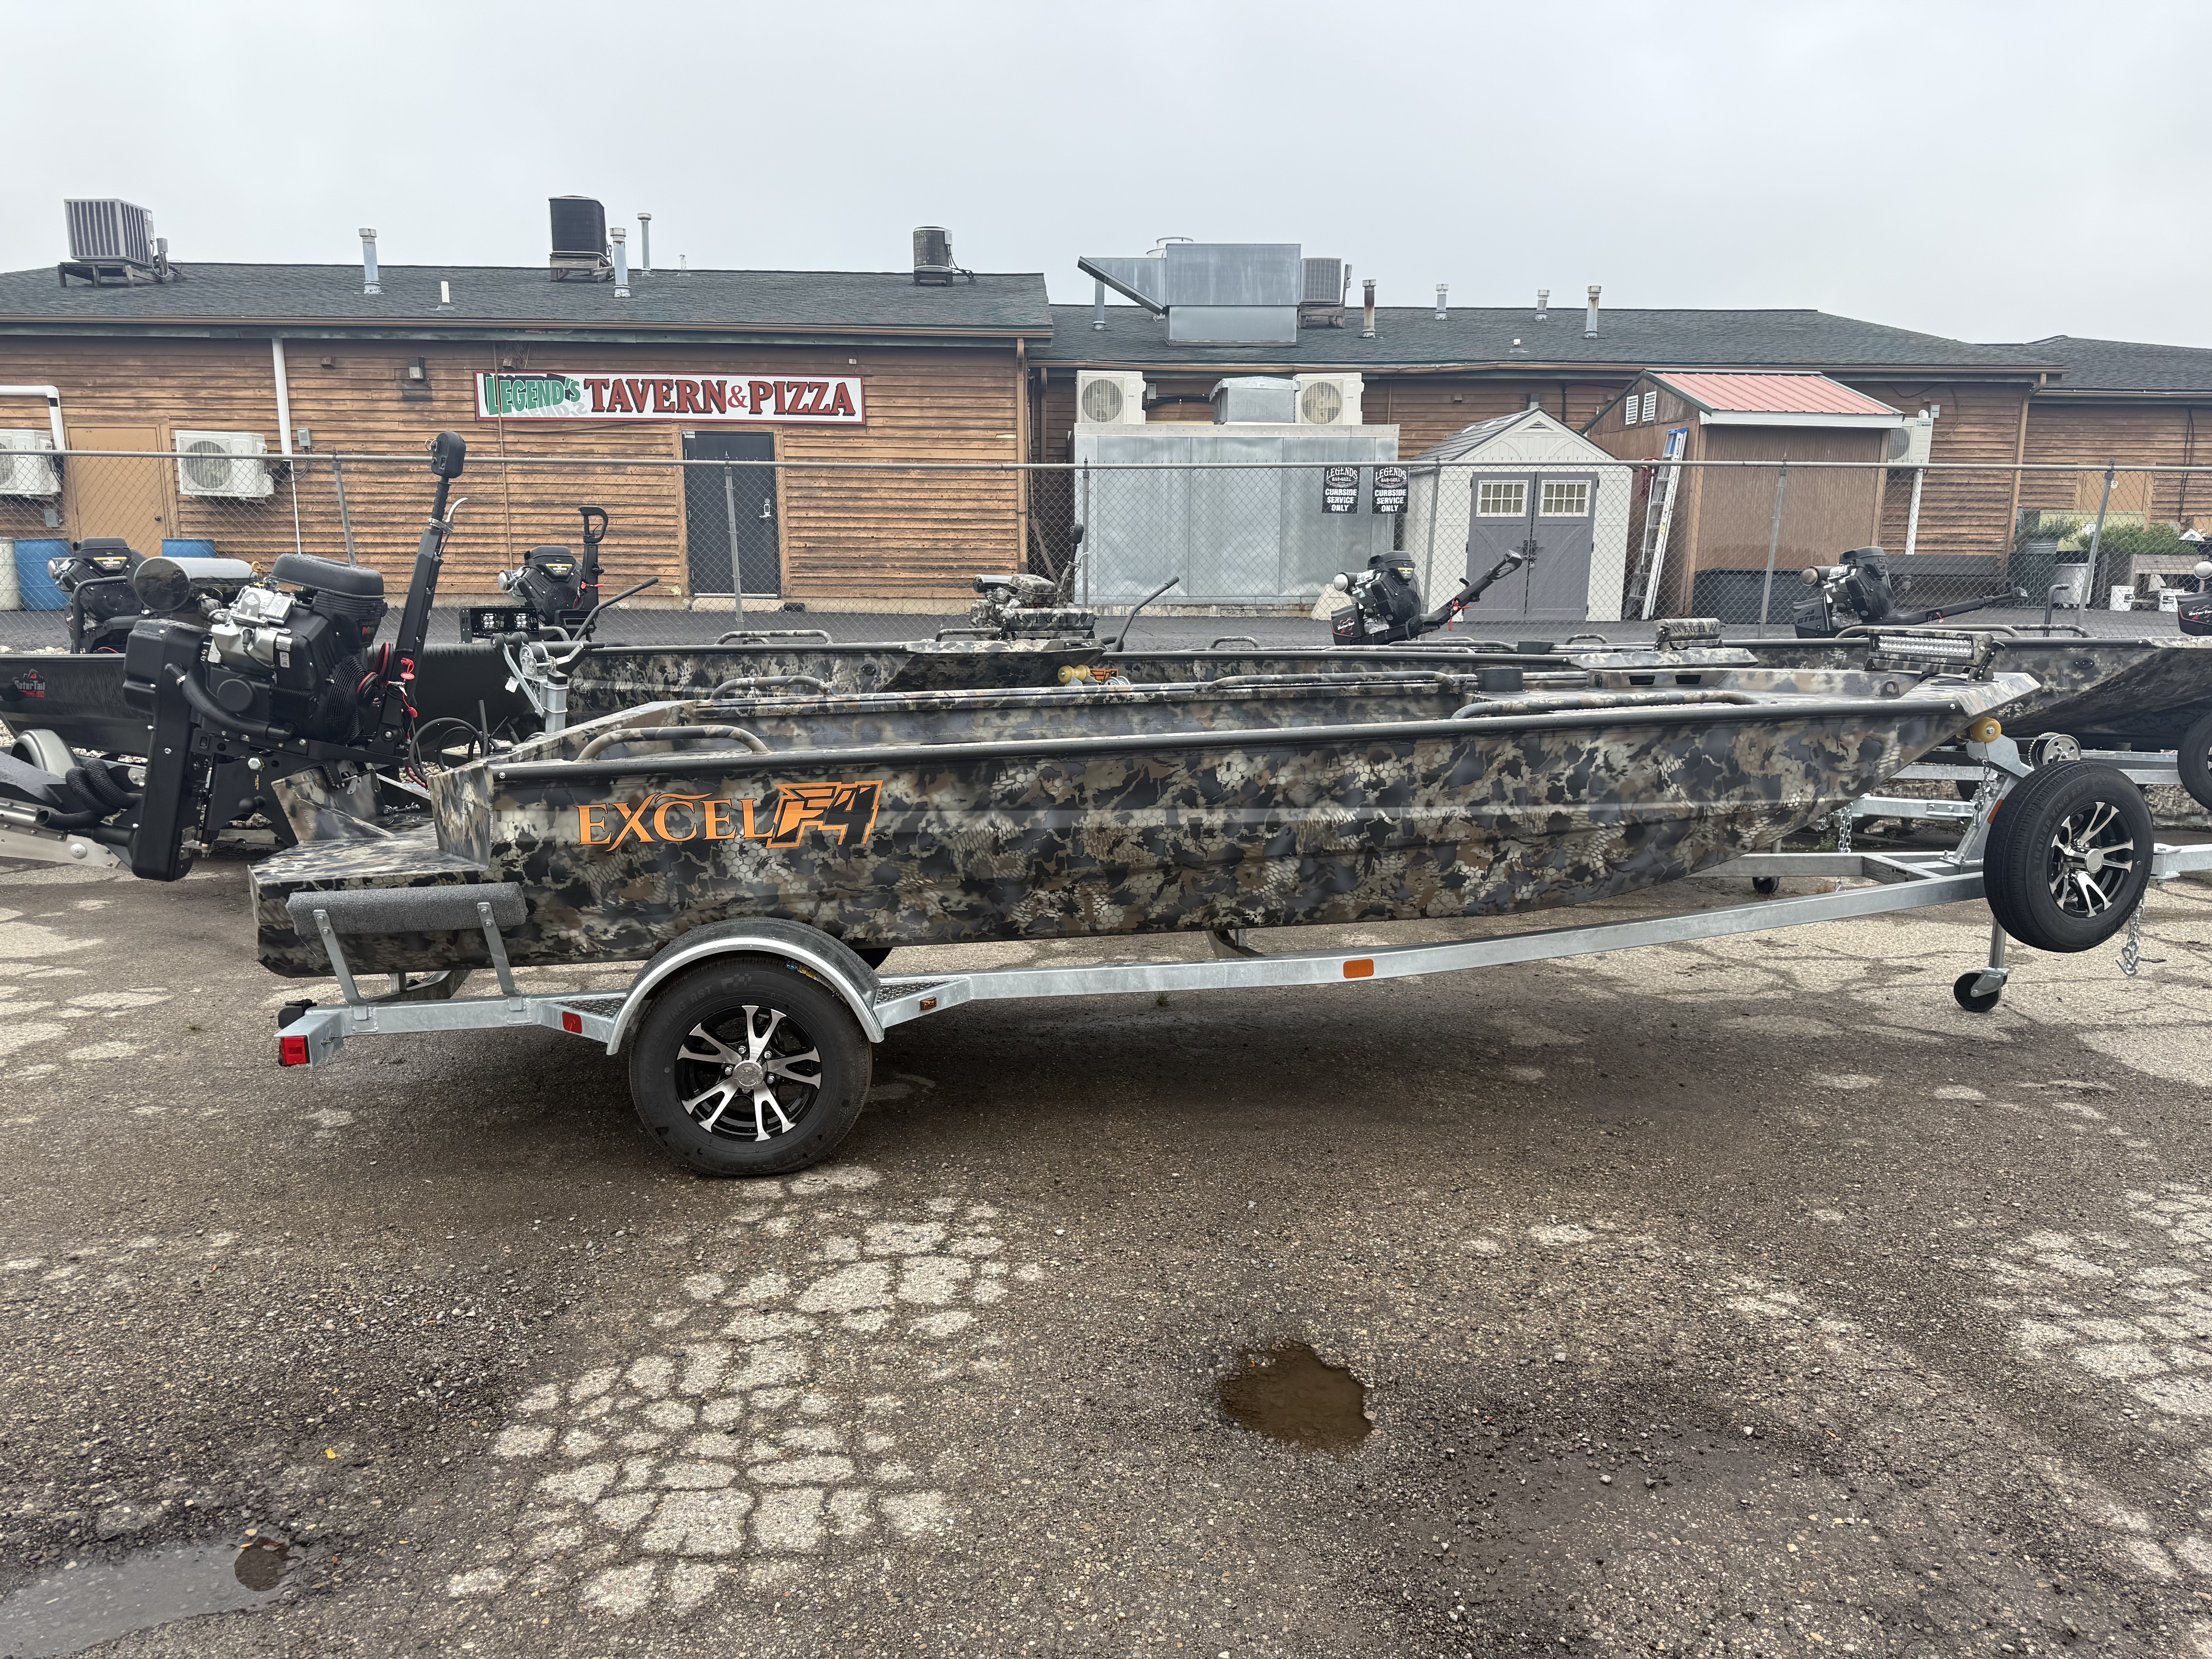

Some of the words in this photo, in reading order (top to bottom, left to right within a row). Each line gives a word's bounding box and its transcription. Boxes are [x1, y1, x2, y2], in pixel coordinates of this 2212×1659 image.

[485, 376, 581, 416] LEGEND'S
[1326, 467, 1358, 480] LEGENDS
[1375, 467, 1407, 481] LEGENDS
[1325, 488, 1357, 496] CURBSIDE
[1374, 489, 1407, 497] CURBSIDE
[1036, 615, 1072, 624] EXCEL
[1684, 624, 1707, 633] EXCEL
[2051, 795, 2070, 819] KING
[2071, 783, 2086, 797] RST
[573, 792, 775, 852] EXCEL
[766, 780, 883, 848] F4
[689, 984, 713, 1004] RST
